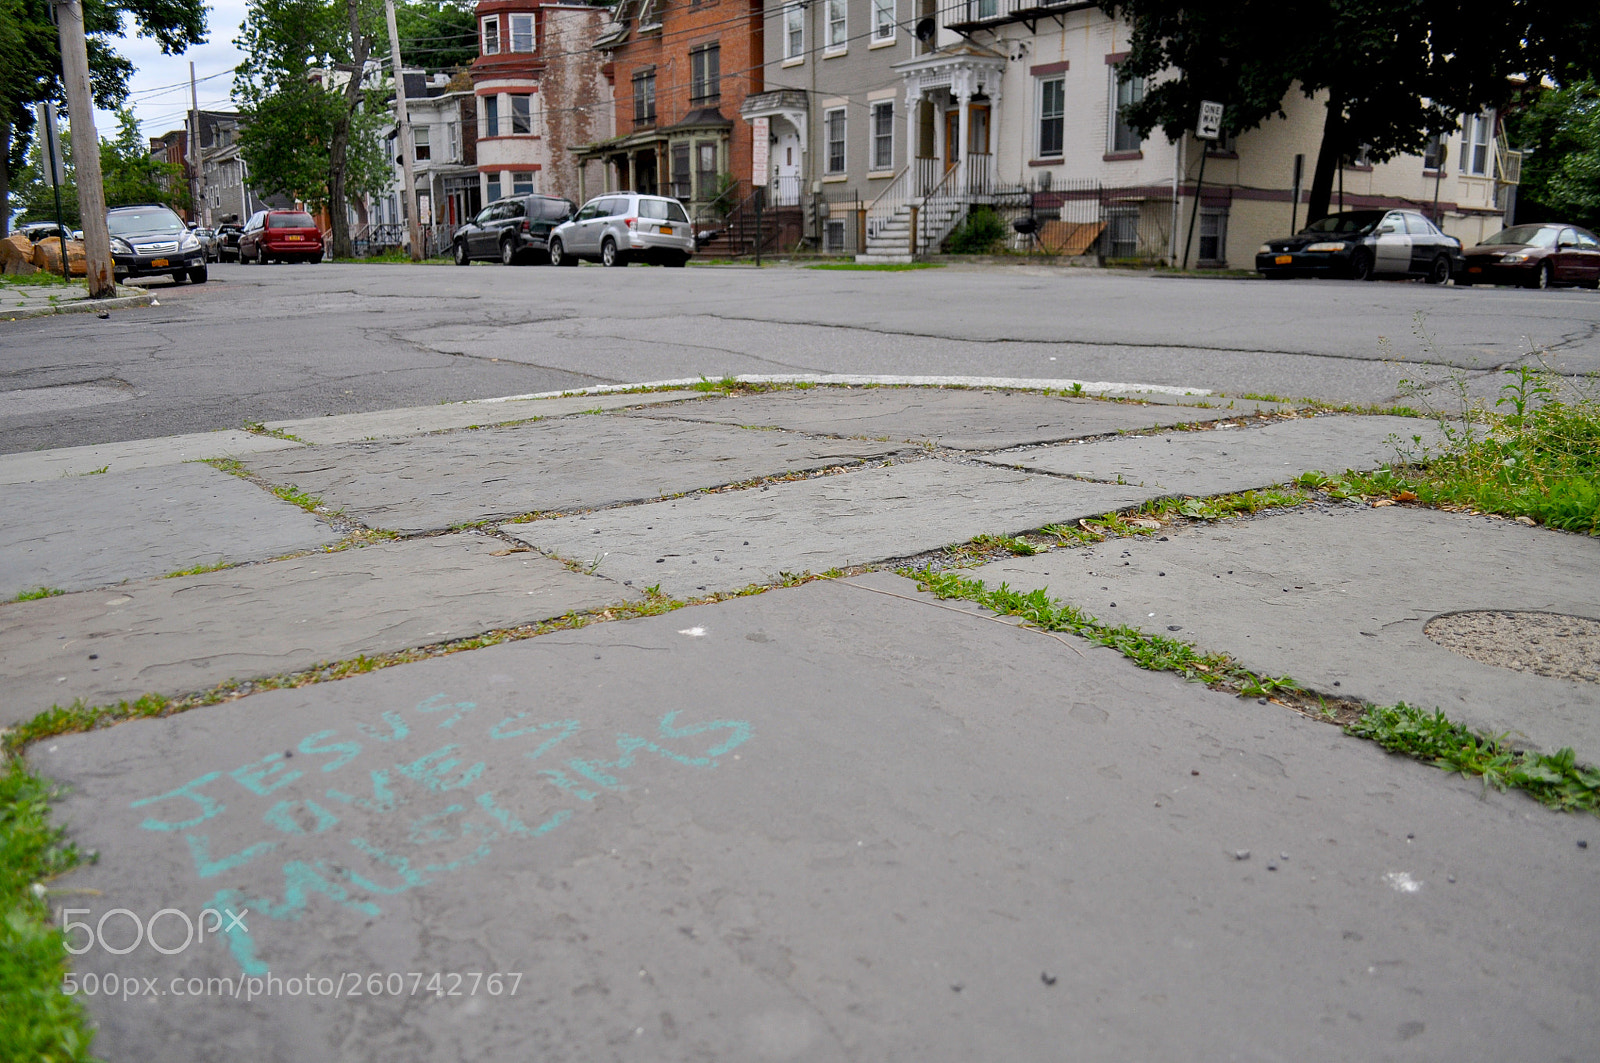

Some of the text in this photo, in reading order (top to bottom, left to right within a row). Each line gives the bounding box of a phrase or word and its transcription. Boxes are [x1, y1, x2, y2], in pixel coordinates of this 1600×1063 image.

[1202, 114, 1220, 126] WAY
[1203, 104, 1221, 116] ONE
[130, 692, 477, 831] JESUS
[187, 712, 581, 878] LOVES
[203, 710, 754, 977] MUSLIMS
